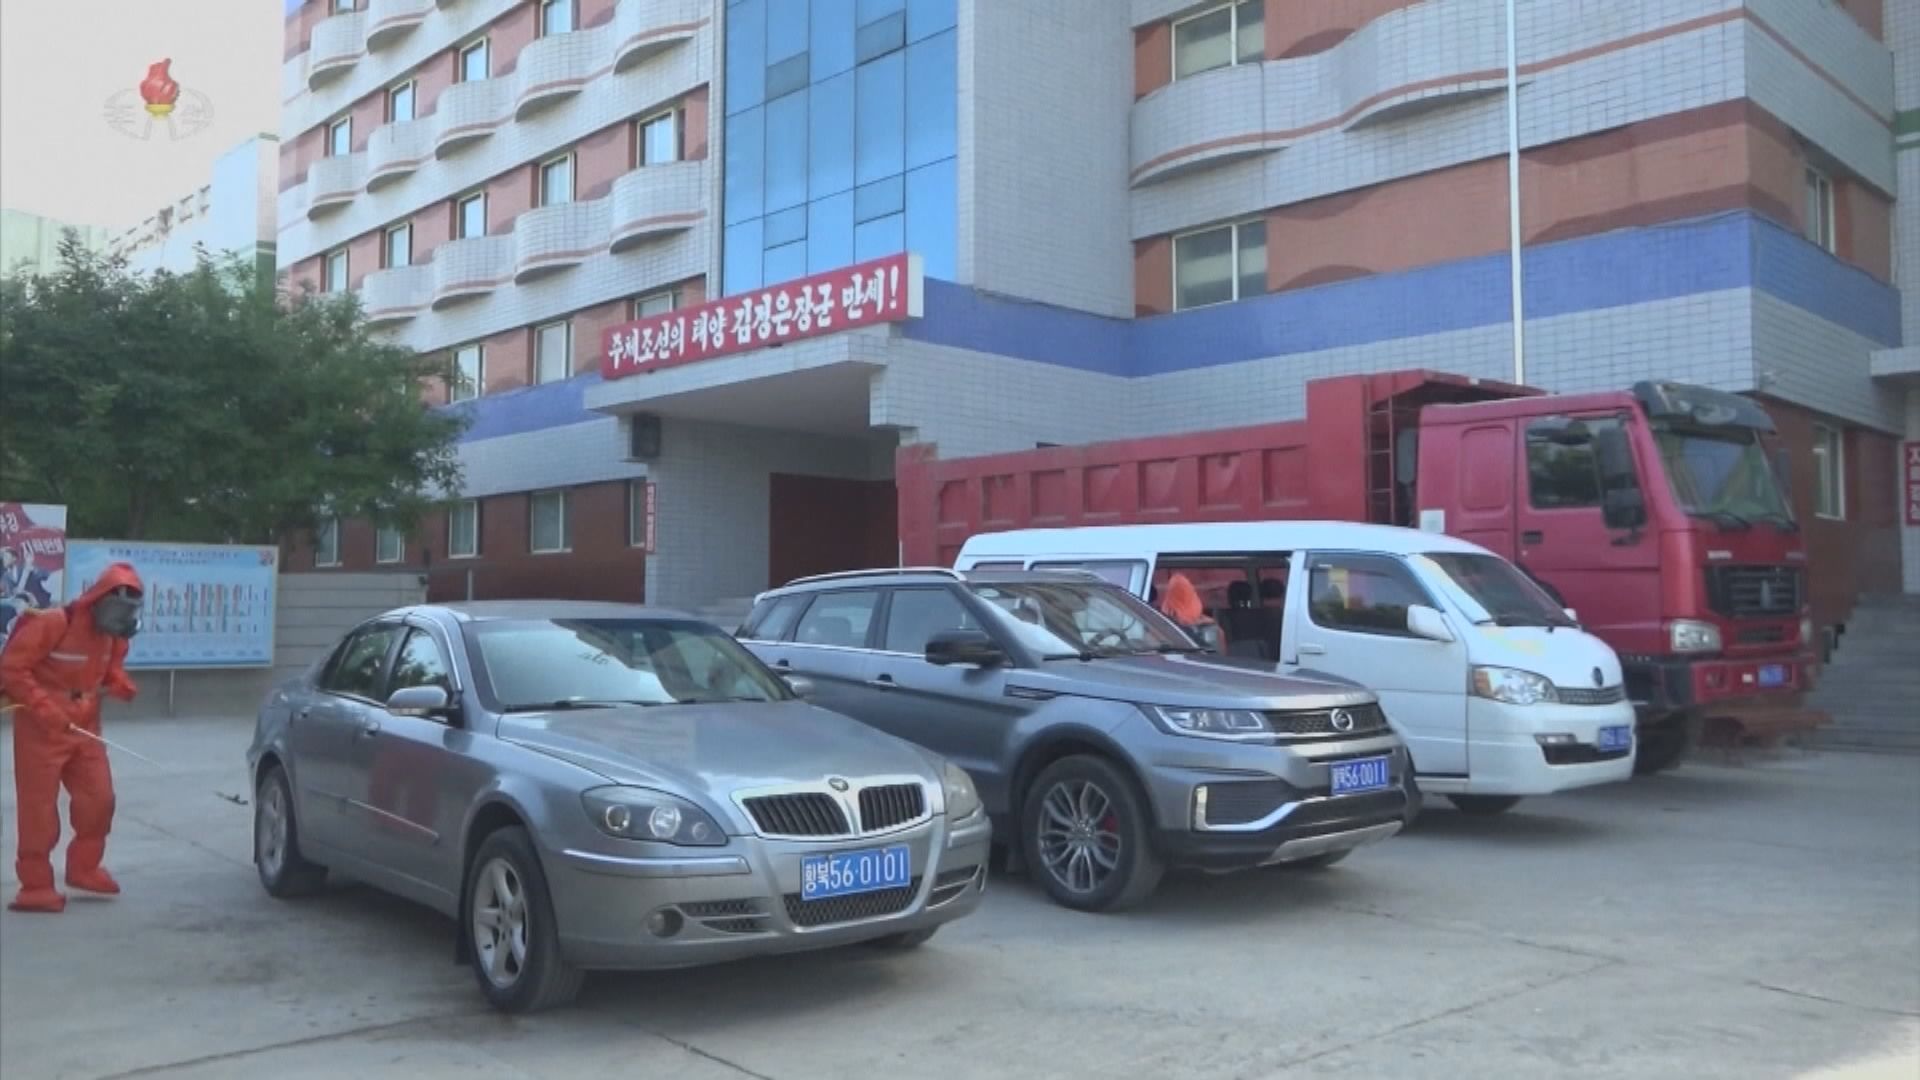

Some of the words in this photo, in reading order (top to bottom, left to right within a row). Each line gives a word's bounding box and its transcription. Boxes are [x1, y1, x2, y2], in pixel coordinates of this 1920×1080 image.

[608, 316, 685, 369] 주체조선의
[691, 306, 728, 352] 태양
[730, 282, 834, 344] 김정은장군
[842, 265, 899, 319] 만세!
